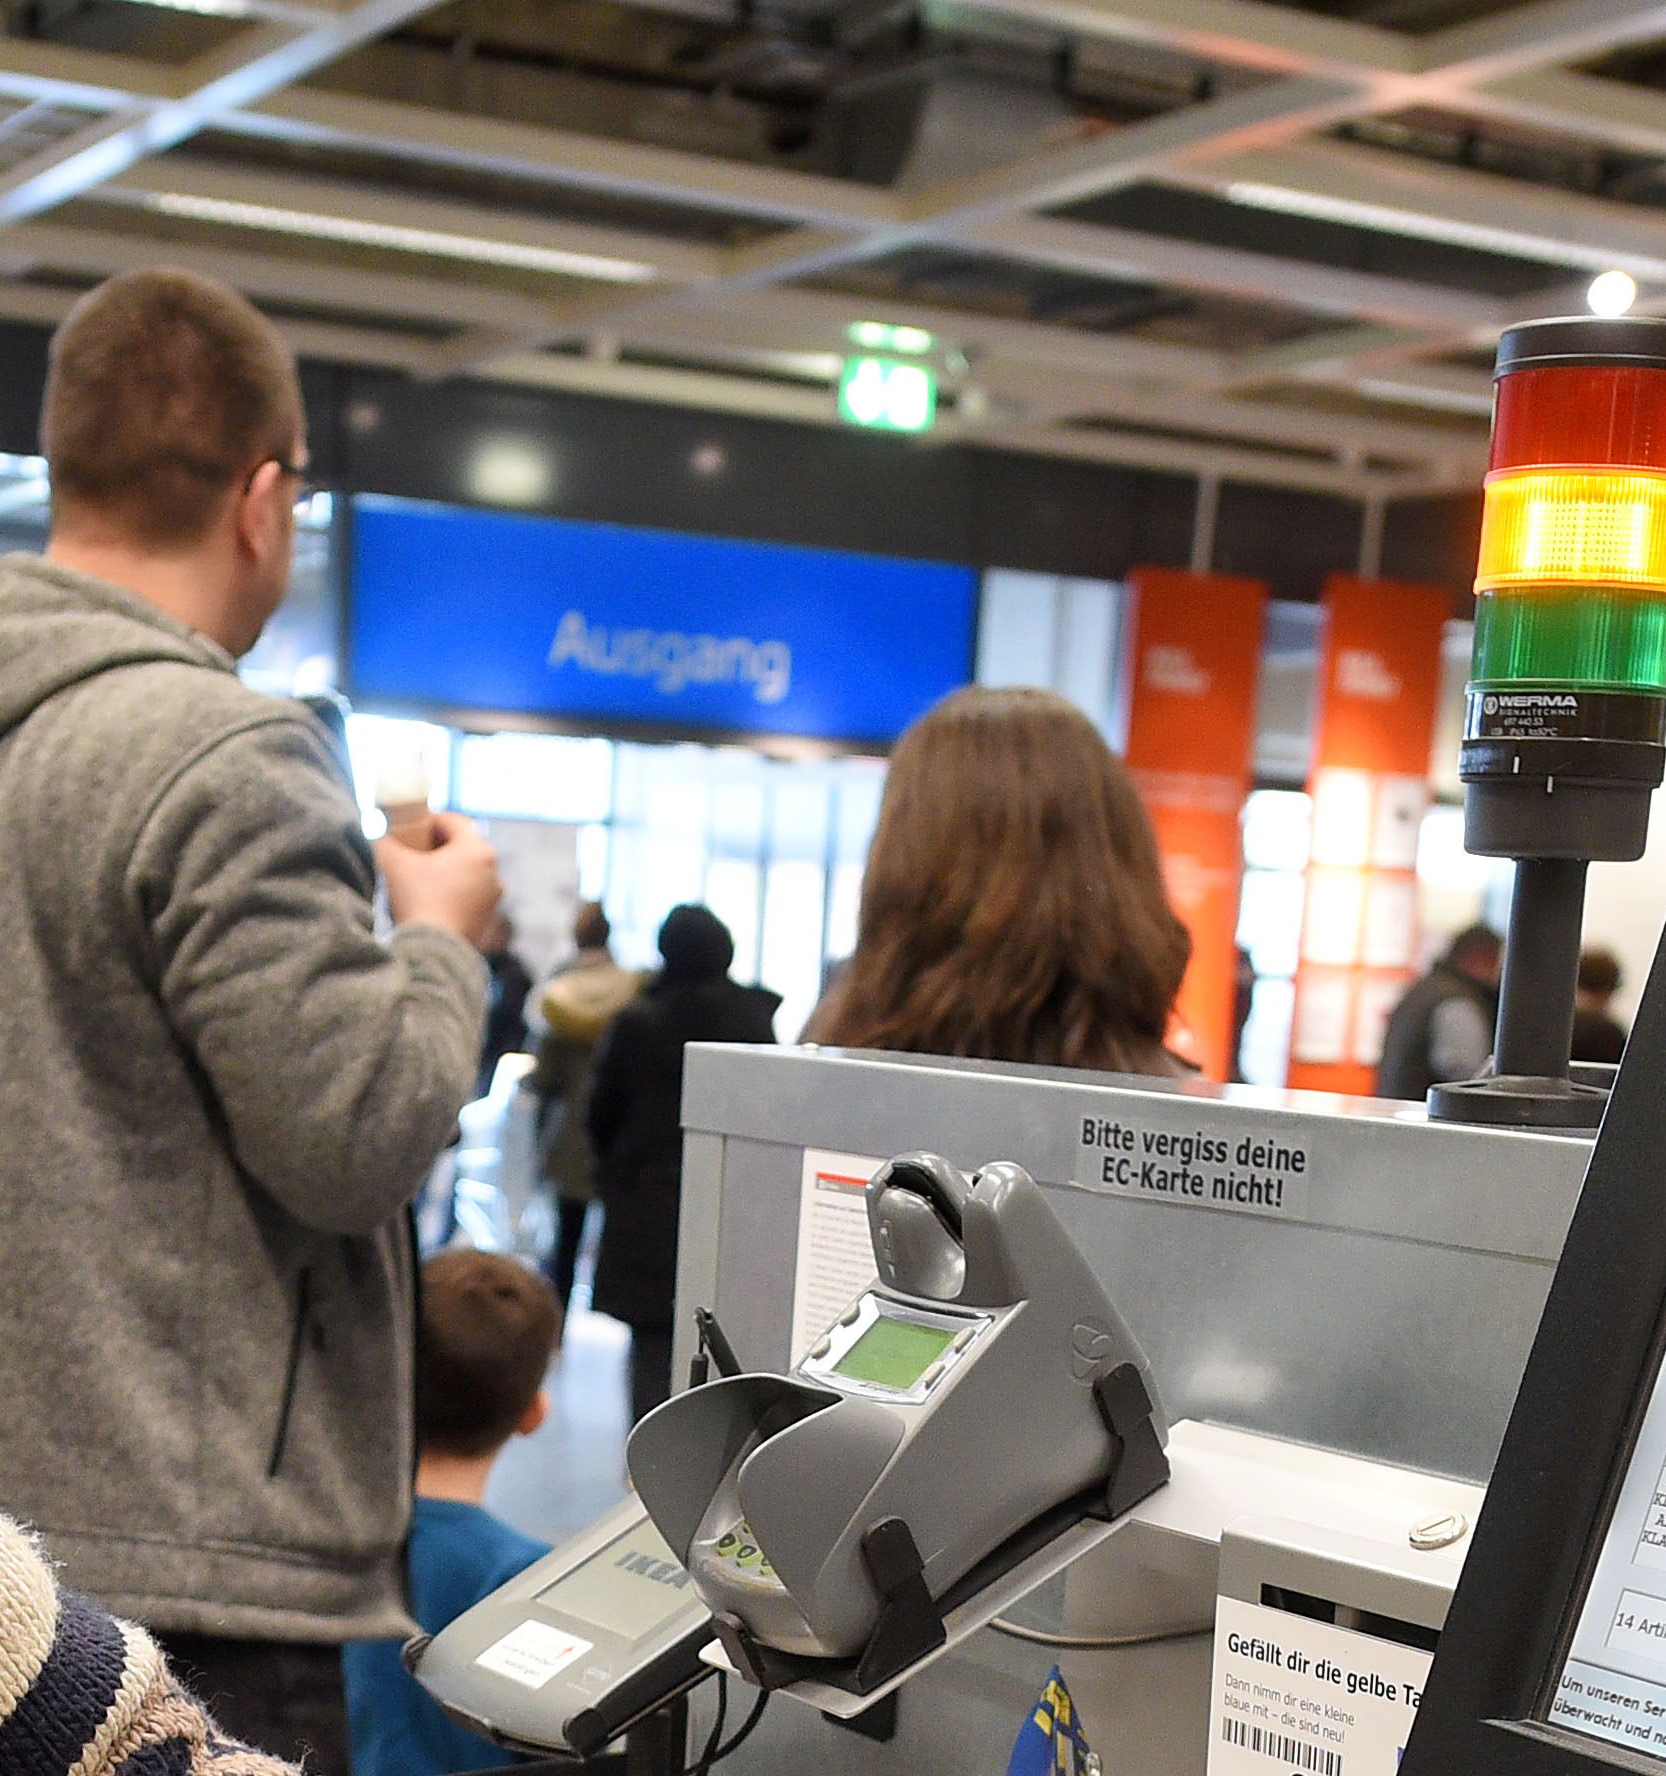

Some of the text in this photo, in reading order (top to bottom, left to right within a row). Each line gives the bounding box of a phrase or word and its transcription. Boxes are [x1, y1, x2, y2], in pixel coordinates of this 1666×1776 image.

[548, 611, 792, 703] Ausgang
[1500, 696, 1578, 707] WERMA
[1081, 1118, 1306, 1173] Bitte vergiss deine
[1102, 1156, 1283, 1207] EC-Karte nicht!
[1615, 1612, 1634, 1629] 14
[1228, 1633, 1283, 1666] Gefällt
[1287, 1650, 1310, 1675] dir
[1315, 1659, 1341, 1684] die
[1347, 1667, 1397, 1700] gelbe
[1224, 1692, 1345, 1743] blaue mit die sind neu!
[1225, 1673, 1355, 1726] Dann nimm dir eine kleine
[1559, 1674, 1585, 1694] Um
[1584, 1683, 1641, 1711] unseren
[1552, 1697, 1623, 1731] überwacht
[1622, 1718, 1652, 1741] und
